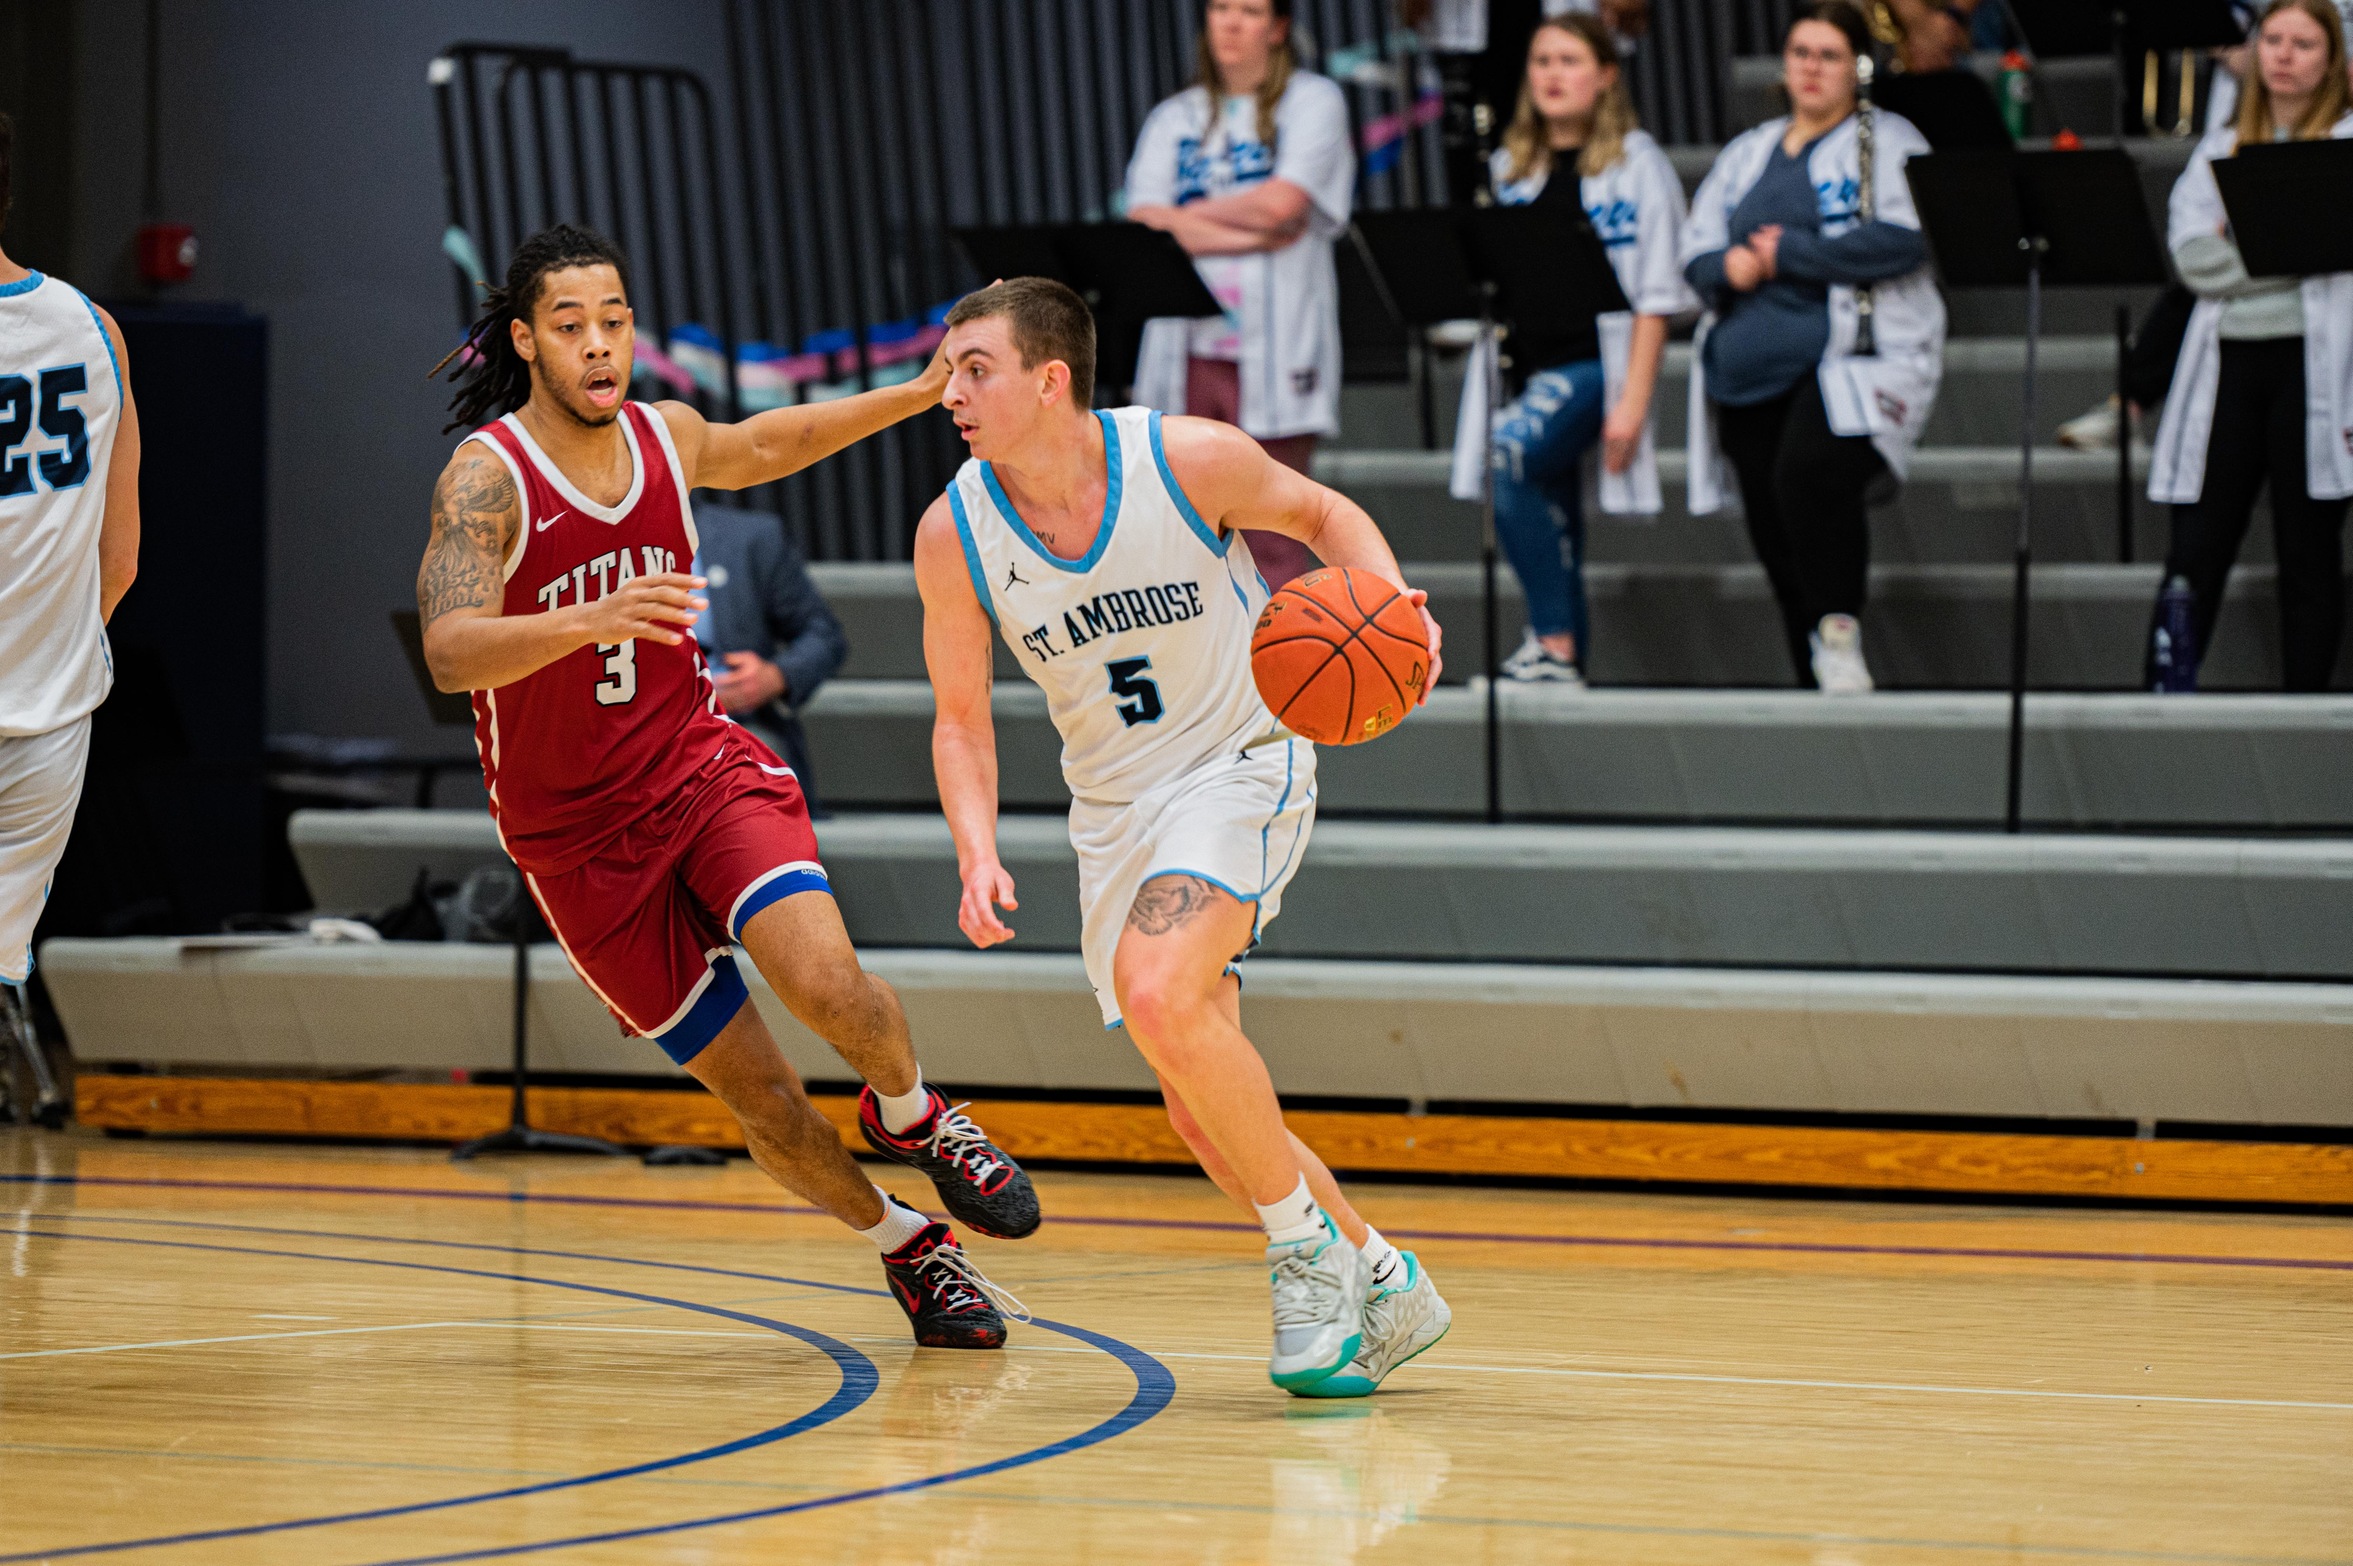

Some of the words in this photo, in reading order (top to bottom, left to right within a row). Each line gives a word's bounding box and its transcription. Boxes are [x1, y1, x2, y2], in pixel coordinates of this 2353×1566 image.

[0, 362, 92, 499] 25
[1022, 624, 1065, 663] ST.
[1062, 580, 1204, 648] AMBROSE
[595, 638, 637, 707] 3
[1104, 654, 1166, 729] 5
